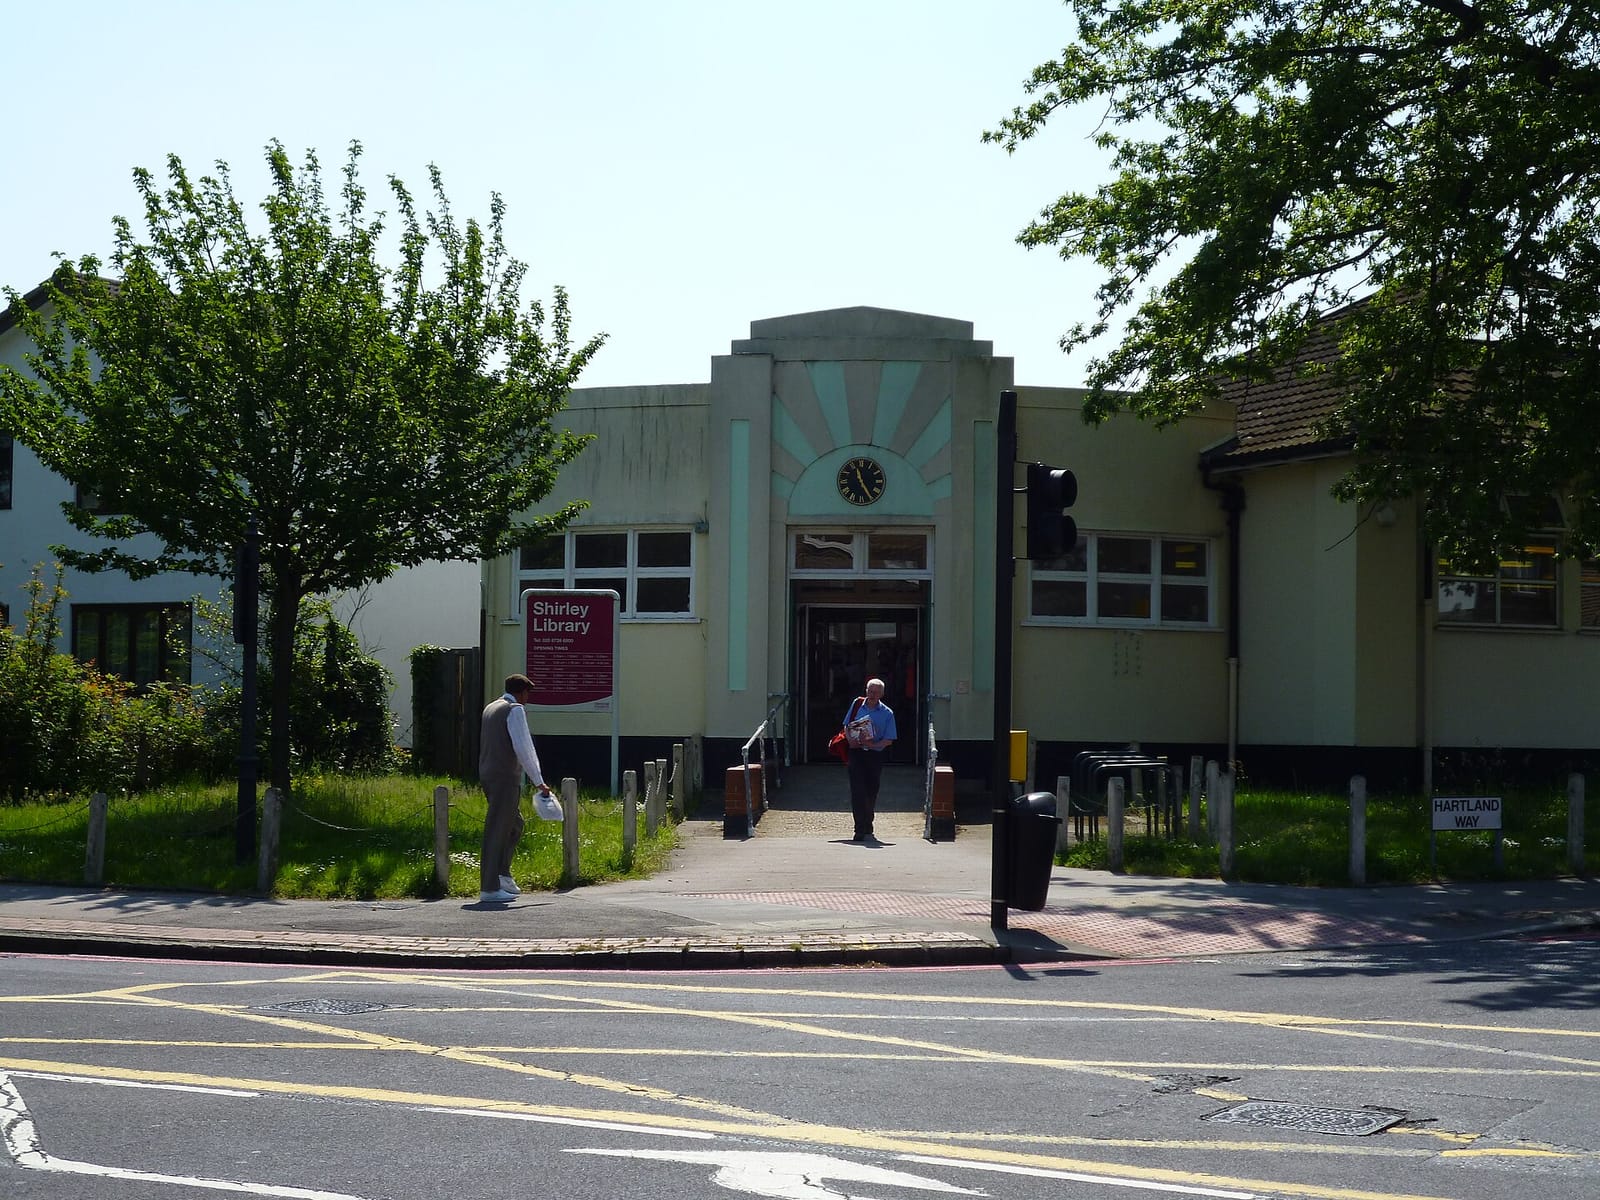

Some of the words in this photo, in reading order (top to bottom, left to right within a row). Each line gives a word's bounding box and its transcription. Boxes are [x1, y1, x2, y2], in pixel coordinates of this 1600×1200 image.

[533, 602, 589, 618] Shirley
[533, 618, 590, 634] Library
[1434, 799, 1499, 812] HARTLAND
[1455, 816, 1480, 828] WAY
